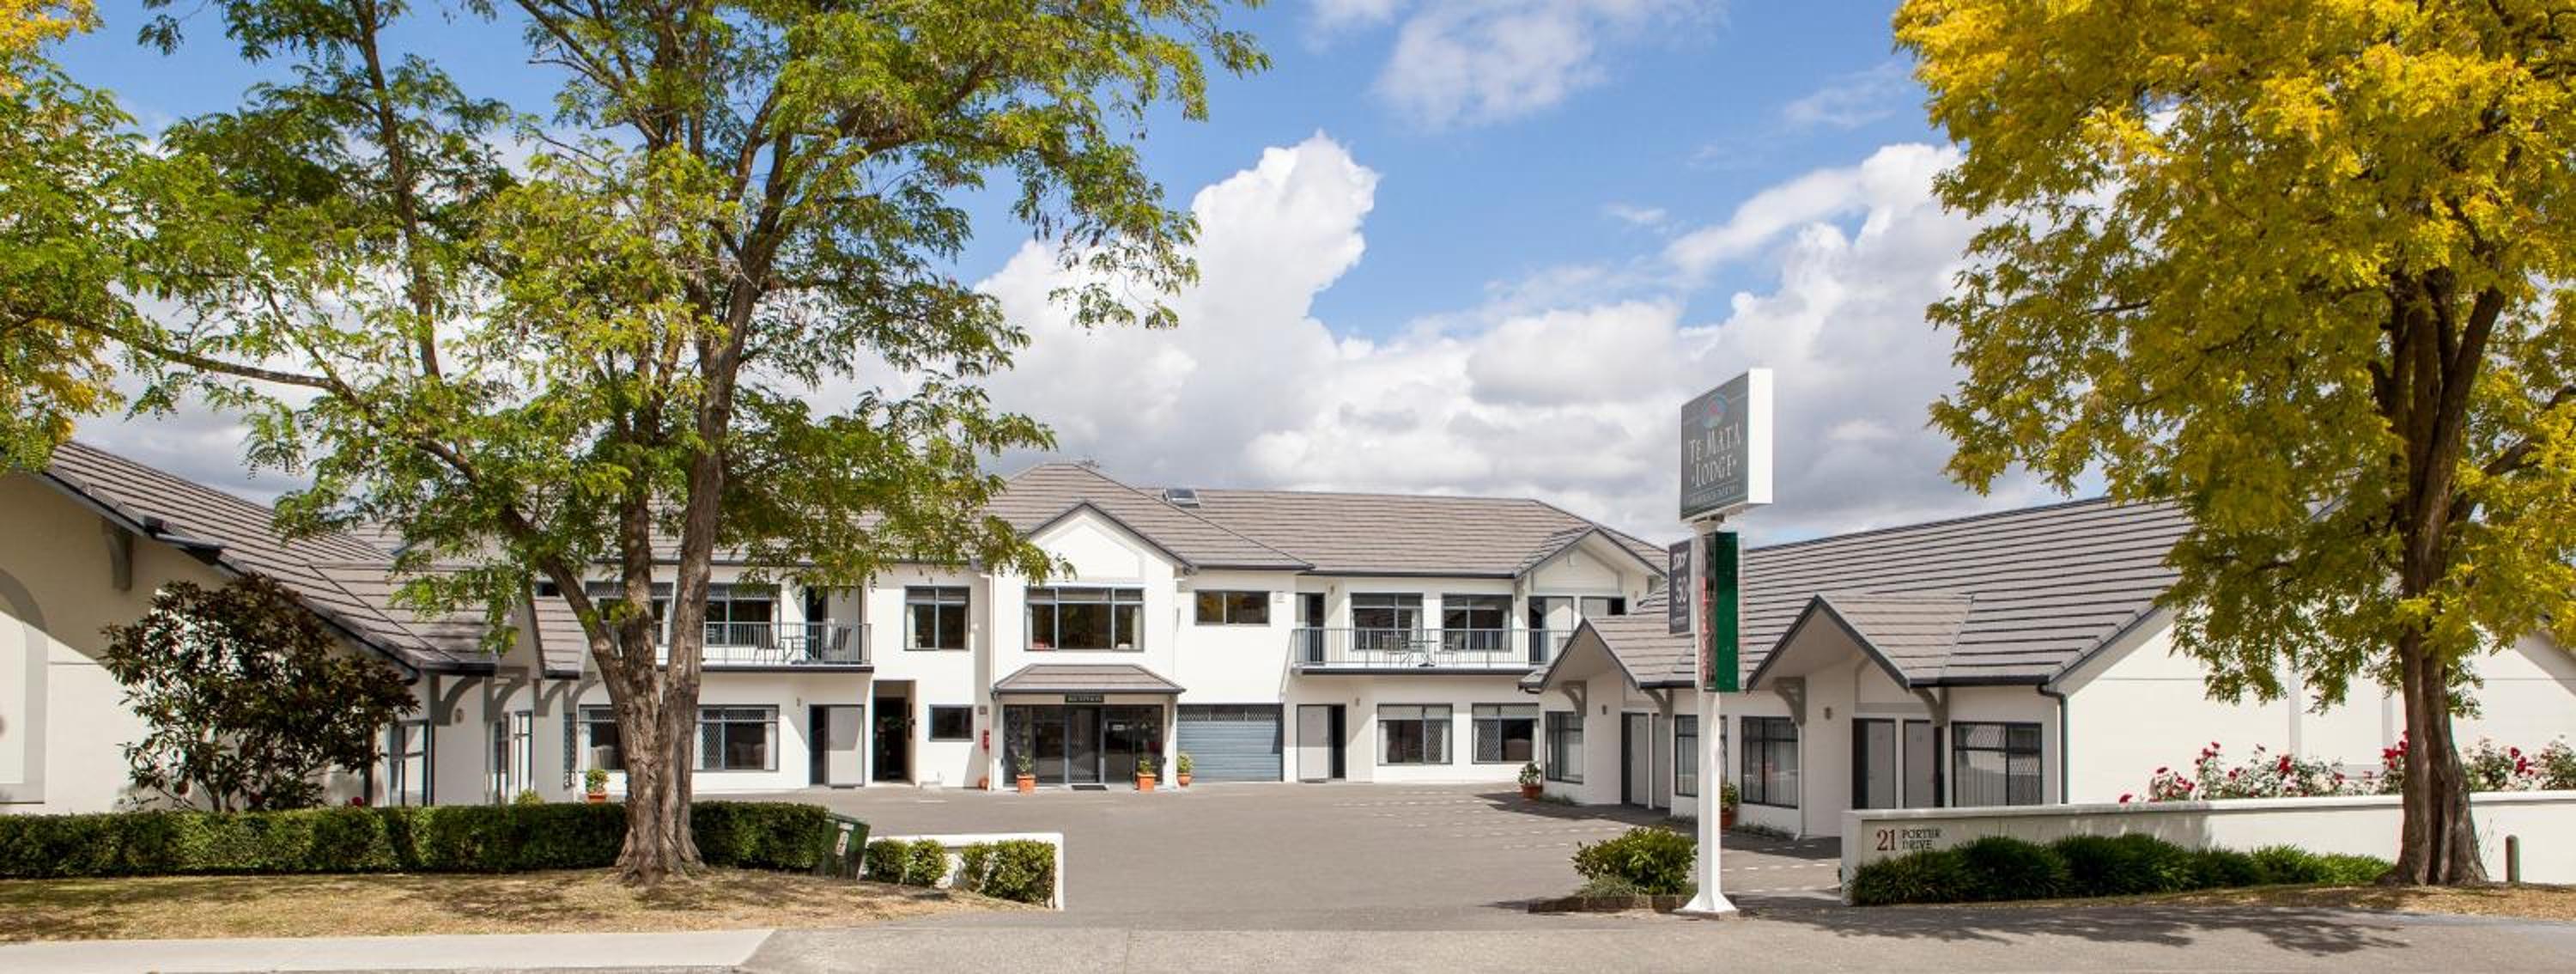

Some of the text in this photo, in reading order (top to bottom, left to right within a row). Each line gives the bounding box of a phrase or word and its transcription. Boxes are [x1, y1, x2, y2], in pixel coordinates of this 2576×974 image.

[1688, 422, 1742, 464] TE MATA
[1876, 829, 1896, 851] 21
[1902, 839, 1934, 849] DRIVE
